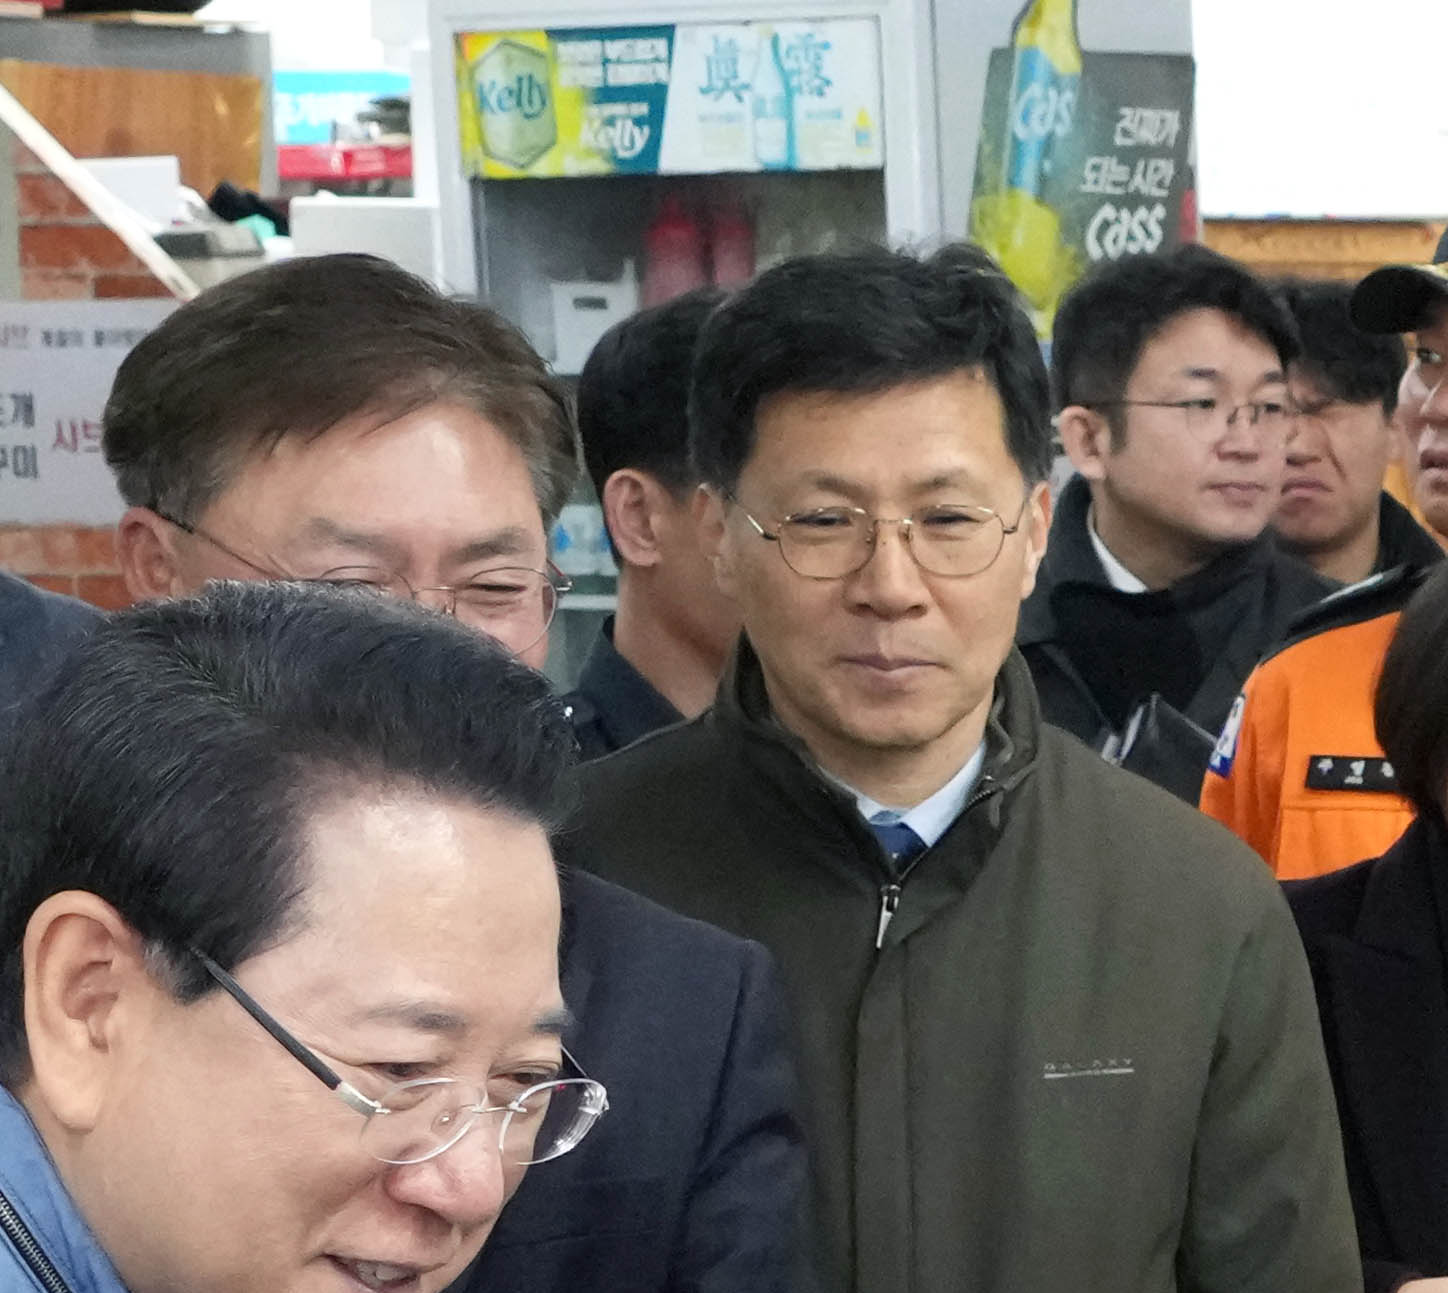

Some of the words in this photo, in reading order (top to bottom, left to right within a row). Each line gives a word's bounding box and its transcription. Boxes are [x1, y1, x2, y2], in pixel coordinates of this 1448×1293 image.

[478, 73, 548, 120] Kelly
[579, 117, 649, 159] Kelly
[1086, 202, 1166, 261] Cass
